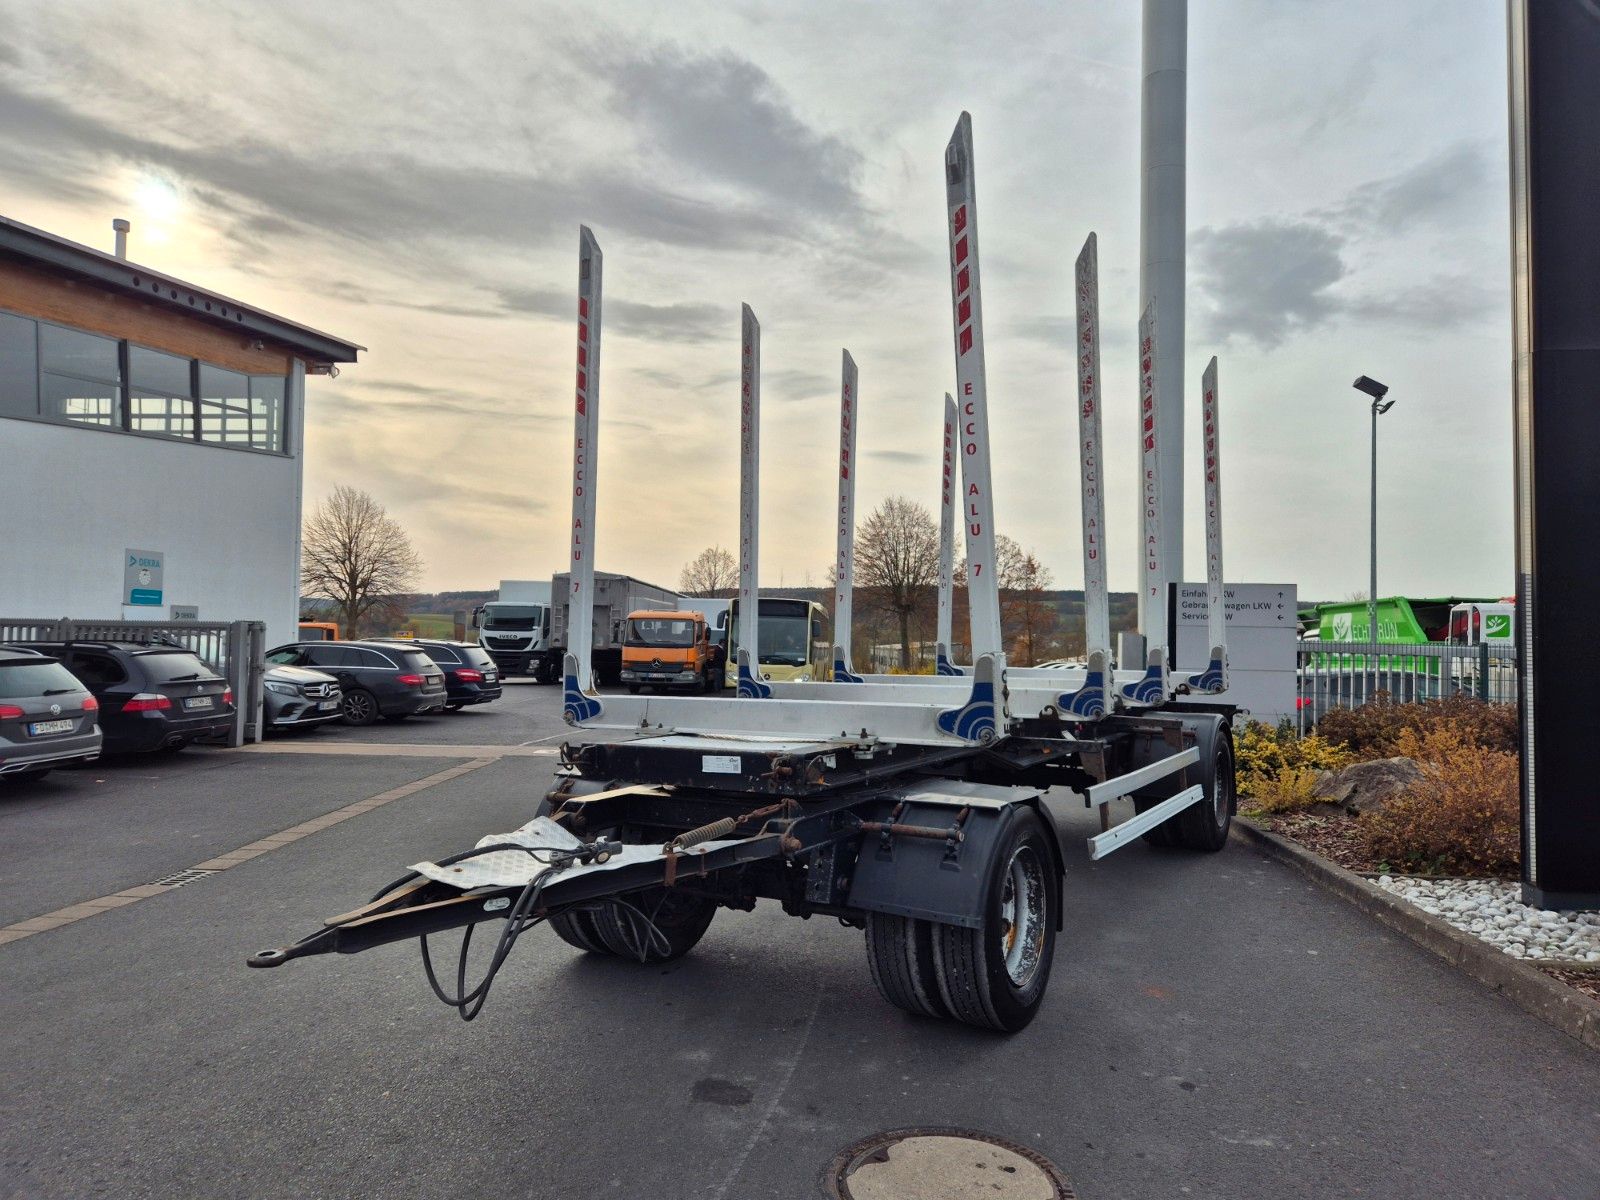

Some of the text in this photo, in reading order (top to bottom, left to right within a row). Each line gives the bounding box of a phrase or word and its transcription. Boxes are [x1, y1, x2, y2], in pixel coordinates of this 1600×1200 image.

[965, 382, 982, 577] ECCO ALU 7
[574, 518, 582, 561] ALU
[1088, 518, 1097, 560] ALU
[1147, 470, 1156, 596] ECCO ALU 7
[139, 558, 161, 568] DEKRA
[574, 582, 580, 593] 7
[1181, 590, 1208, 598] Einfah
[1252, 602, 1272, 610] LKW
[1181, 612, 1209, 620] Servic
[1352, 618, 1399, 641] ECHTRÜN
